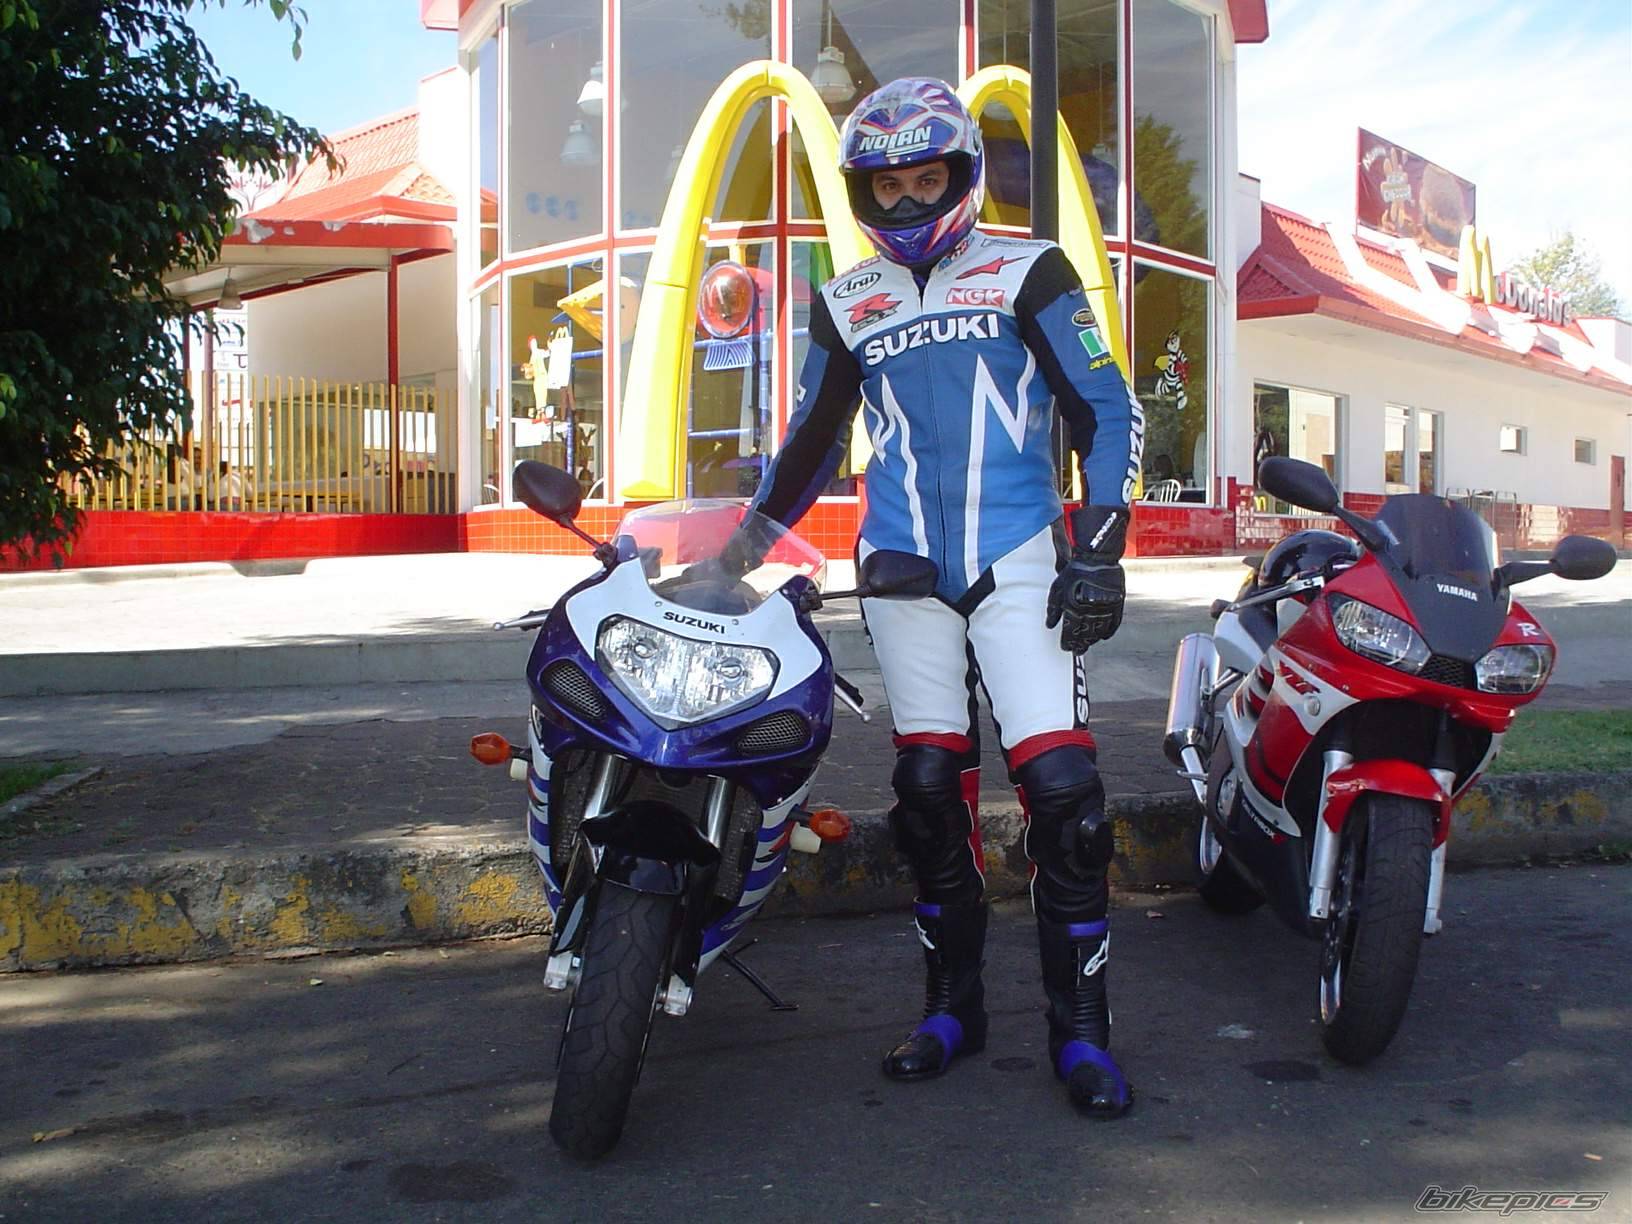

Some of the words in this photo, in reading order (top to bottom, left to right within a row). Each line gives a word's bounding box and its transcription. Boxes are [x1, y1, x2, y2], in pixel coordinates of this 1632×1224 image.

[859, 126, 932, 151] NOLAN
[947, 288, 1006, 306] NGK
[864, 313, 1000, 366] SUZUKI
[1436, 583, 1478, 602] YAMAHA
[663, 611, 725, 634] SUZUKI
